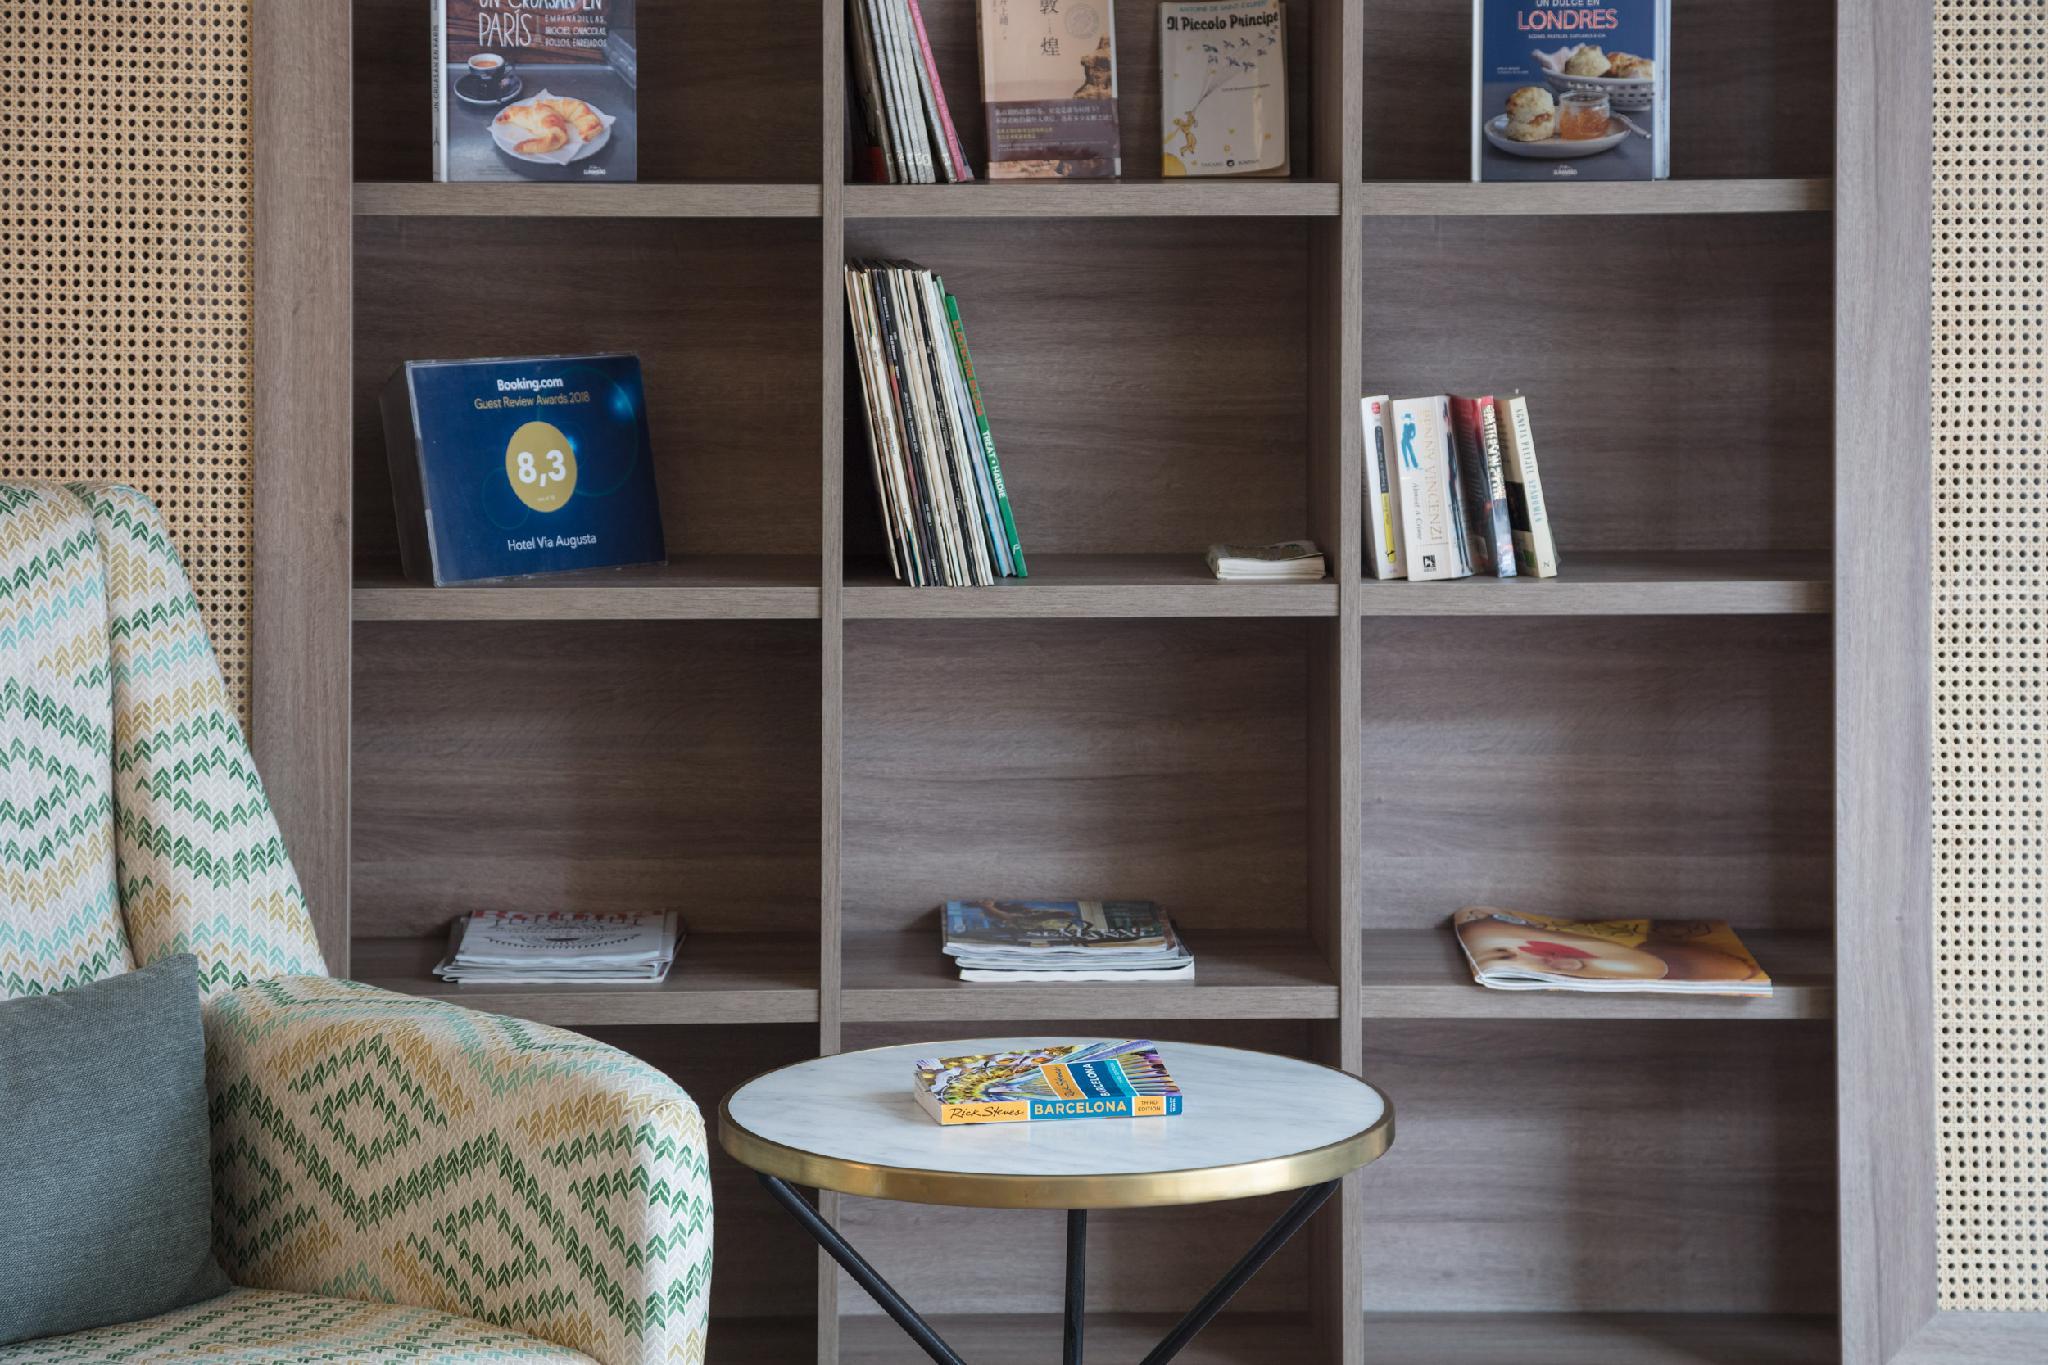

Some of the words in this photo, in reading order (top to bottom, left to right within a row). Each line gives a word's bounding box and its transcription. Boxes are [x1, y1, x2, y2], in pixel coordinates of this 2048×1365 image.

[478, 9, 532, 47] PARÍS
[1180, 15, 1227, 31] Piccolo
[1229, 11, 1279, 29] Principe
[1517, 8, 1619, 30] LONDRES
[496, 377, 564, 392] Booking.com
[474, 397, 502, 410] Guest
[502, 395, 535, 408] Review
[535, 393, 568, 406] Awards
[568, 391, 591, 404] 2018
[517, 449, 567, 487] 8,3
[982, 430, 996, 459] TREAT
[991, 465, 1006, 499] HARDIE
[507, 536, 536, 551] Hotel
[537, 535, 554, 549] Via
[555, 533, 597, 549] Augusta
[1082, 1062, 1111, 1097] BARCELONA
[950, 1107, 984, 1120] Rick
[1034, 1100, 1128, 1115] BARCELONA
